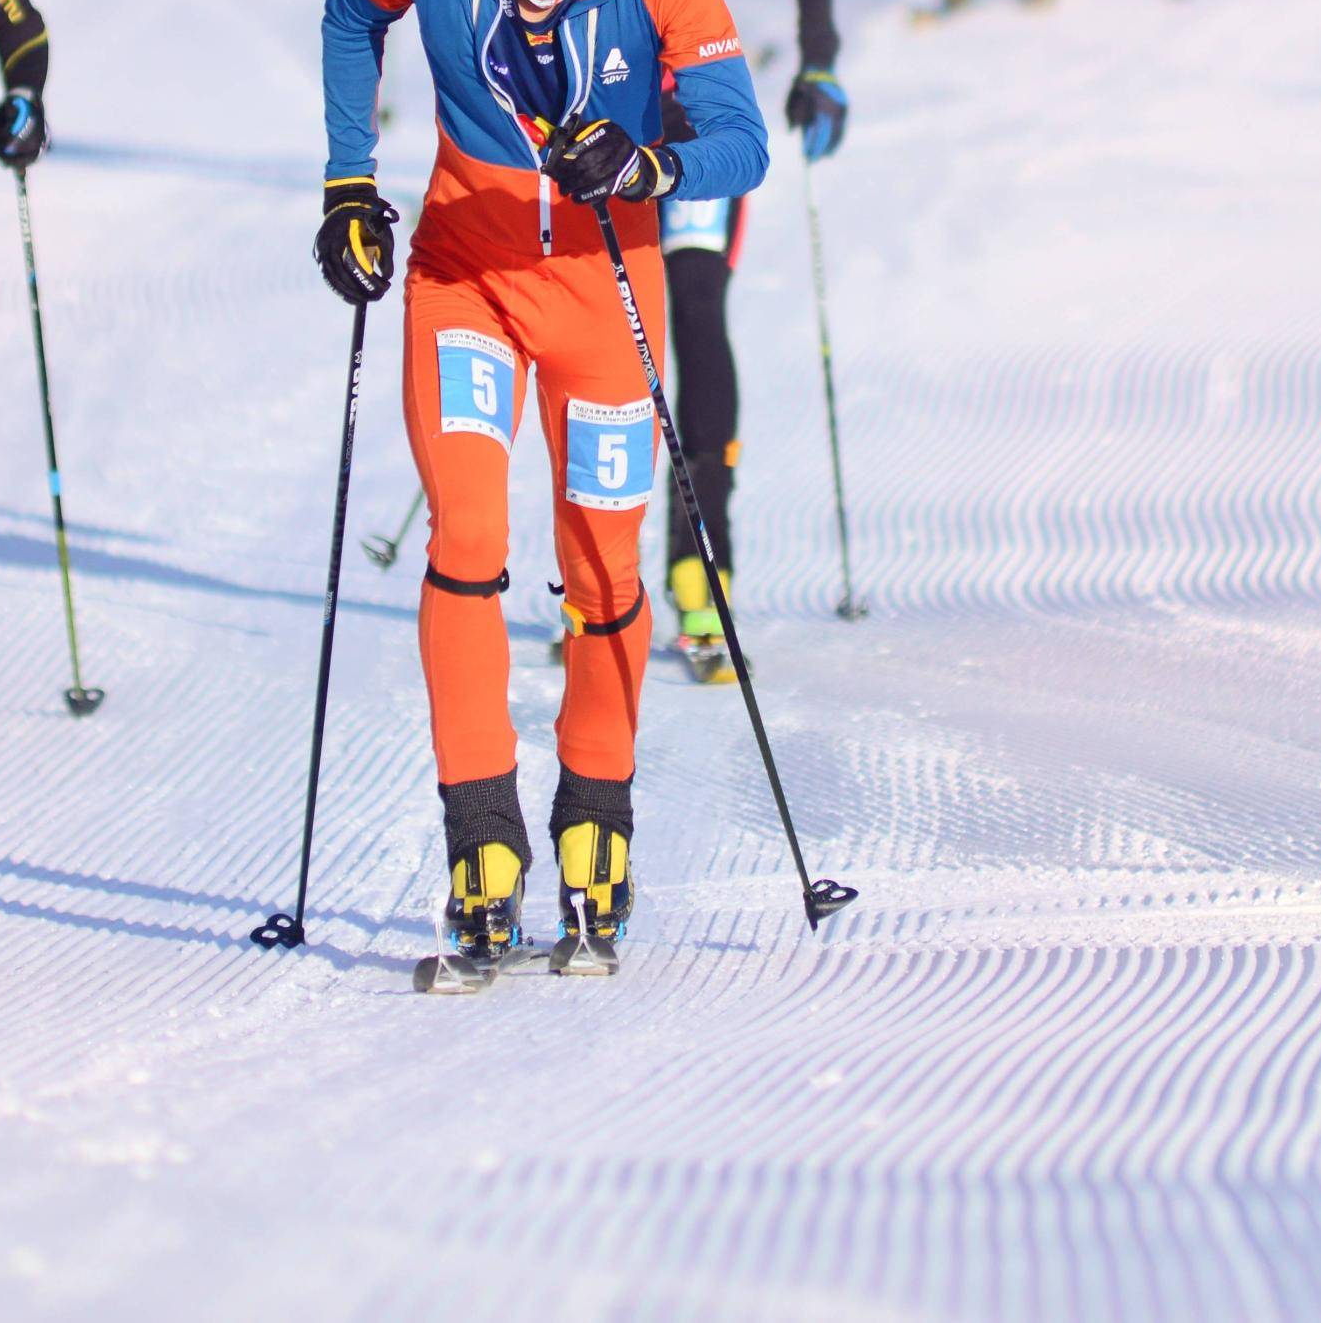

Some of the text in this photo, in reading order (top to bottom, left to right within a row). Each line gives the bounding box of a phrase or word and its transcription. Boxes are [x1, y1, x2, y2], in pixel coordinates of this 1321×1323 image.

[603, 74, 629, 85] ADVT
[471, 357, 497, 416] 5
[597, 433, 628, 489] 5
